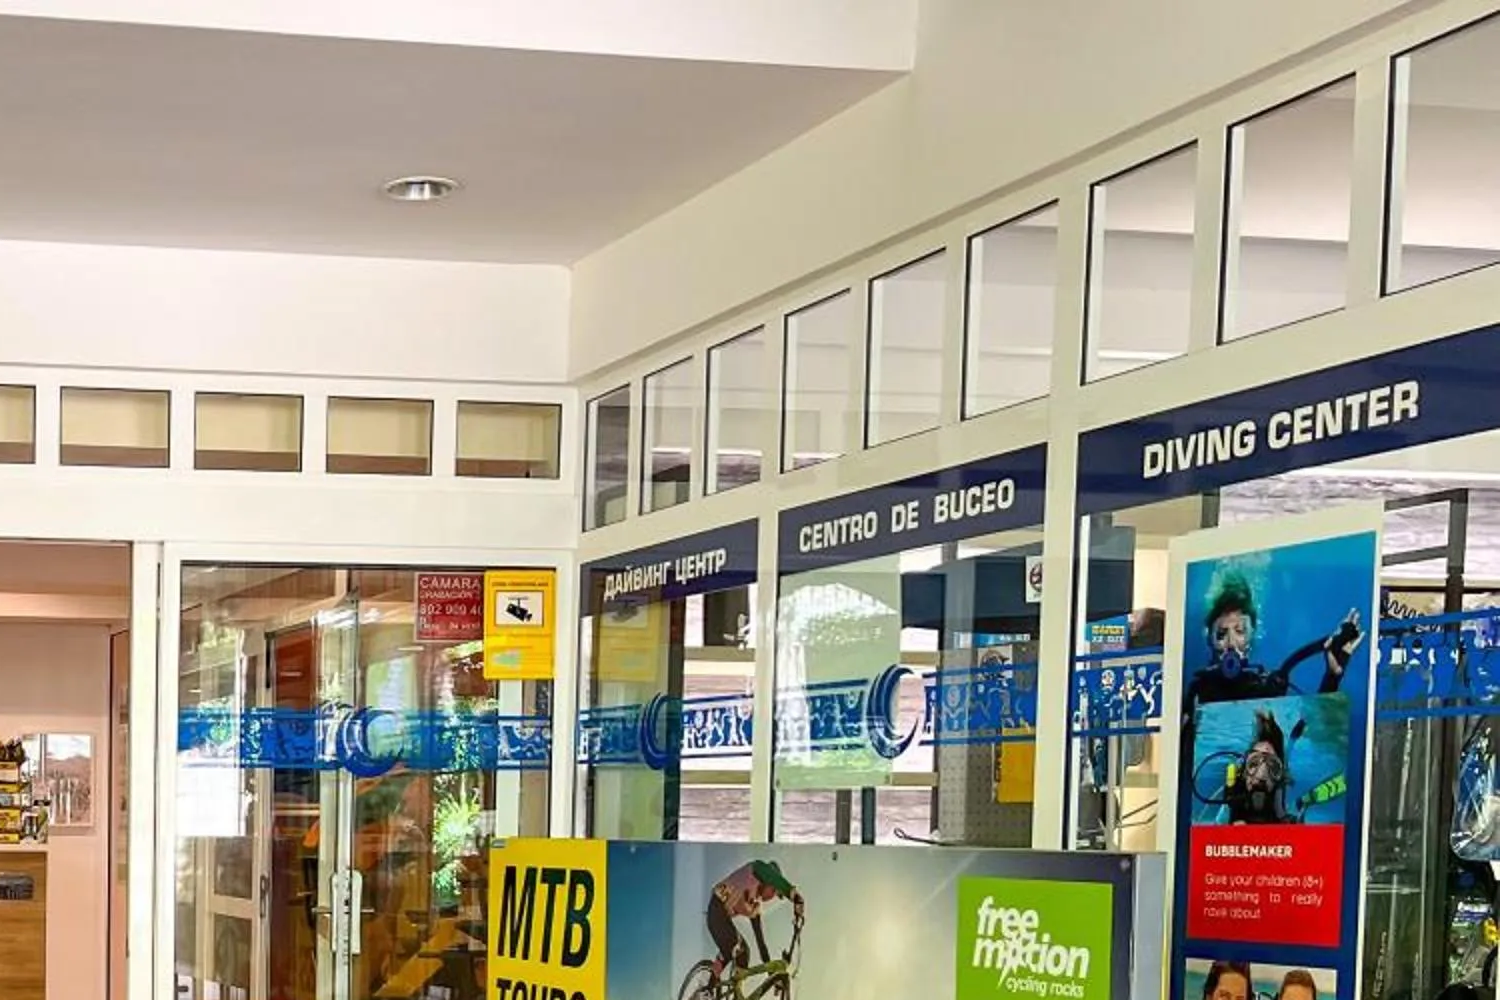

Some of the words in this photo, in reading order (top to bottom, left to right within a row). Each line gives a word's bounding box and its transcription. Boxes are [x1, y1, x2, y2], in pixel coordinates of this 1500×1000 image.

[1143, 420, 1256, 479] DIVING
[1267, 380, 1419, 450] CENTER
[800, 511, 878, 552] CENTRO
[891, 501, 919, 533] DE
[933, 478, 1015, 523] BUCEO
[604, 564, 672, 602] ДАЙВИНГ
[675, 548, 727, 585] ЦЕНТР
[1205, 845, 1293, 858] BUBBLEMAKER
[1204, 891, 1260, 905] something
[1269, 892, 1281, 903] to
[1291, 893, 1323, 908] really
[1205, 873, 1227, 886] Give
[1229, 874, 1253, 887] your
[1256, 875, 1301, 888] children
[497, 865, 595, 968] MTB
[977, 896, 1039, 938] free
[1005, 977, 1047, 998] cycling
[1051, 982, 1085, 998] rocks
